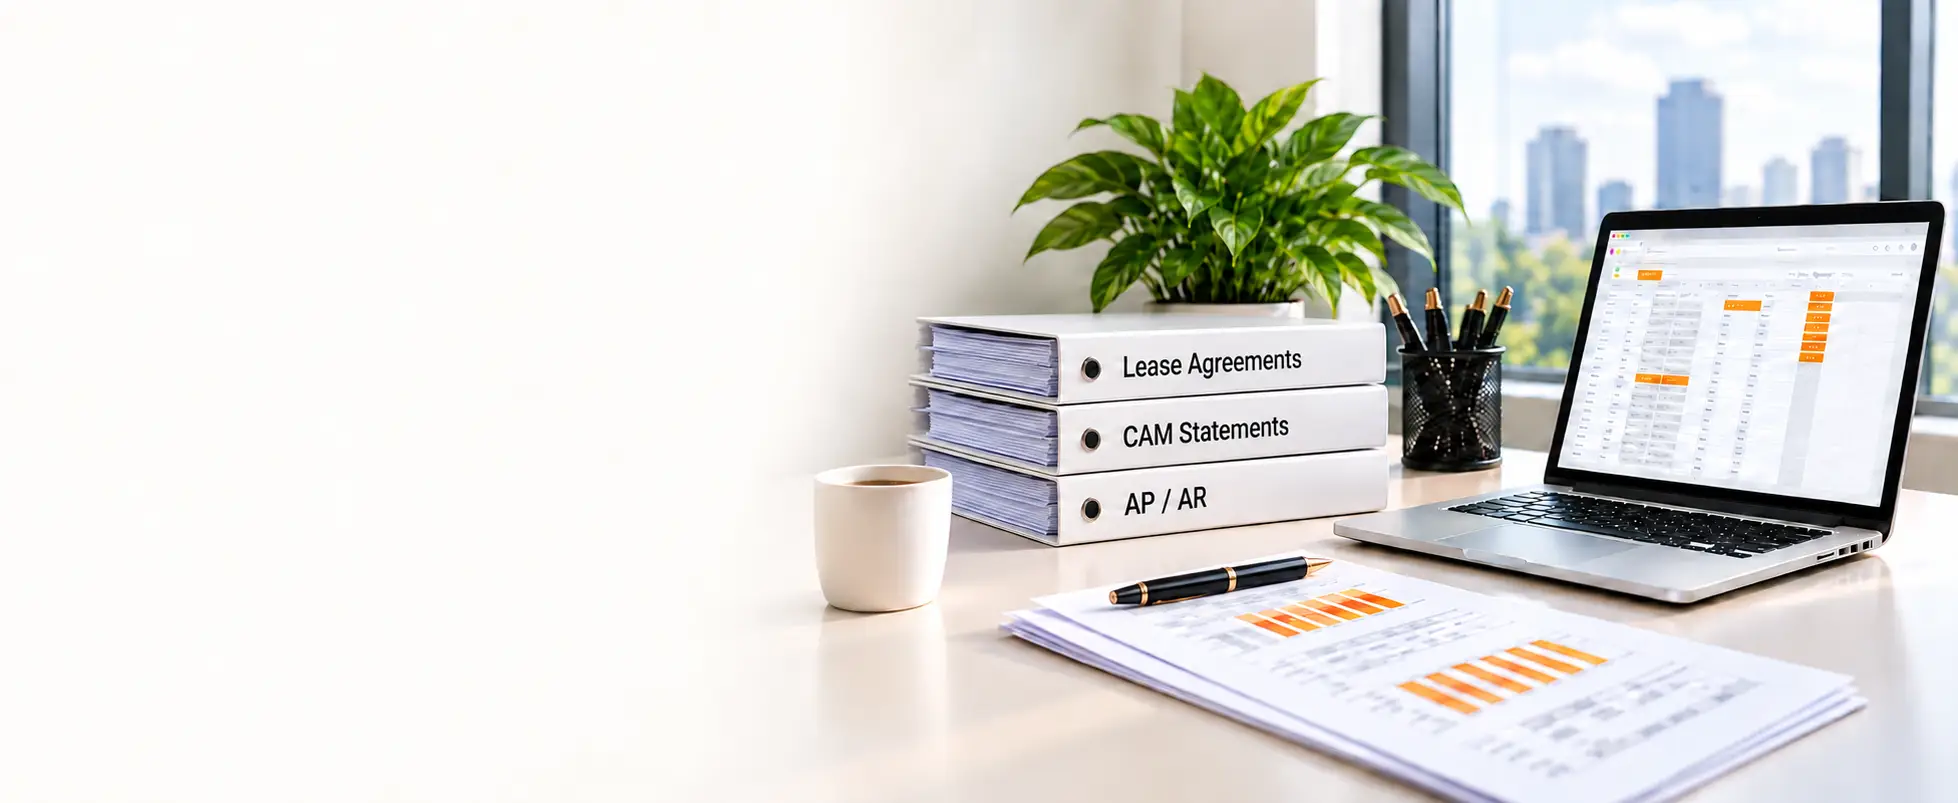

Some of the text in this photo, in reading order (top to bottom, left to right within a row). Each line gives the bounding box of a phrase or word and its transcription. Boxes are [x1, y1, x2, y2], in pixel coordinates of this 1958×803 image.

[1122, 349, 1302, 380] Lease Agreements
[1123, 416, 1290, 448] CAM Statements
[1124, 486, 1207, 516] AP / AR
